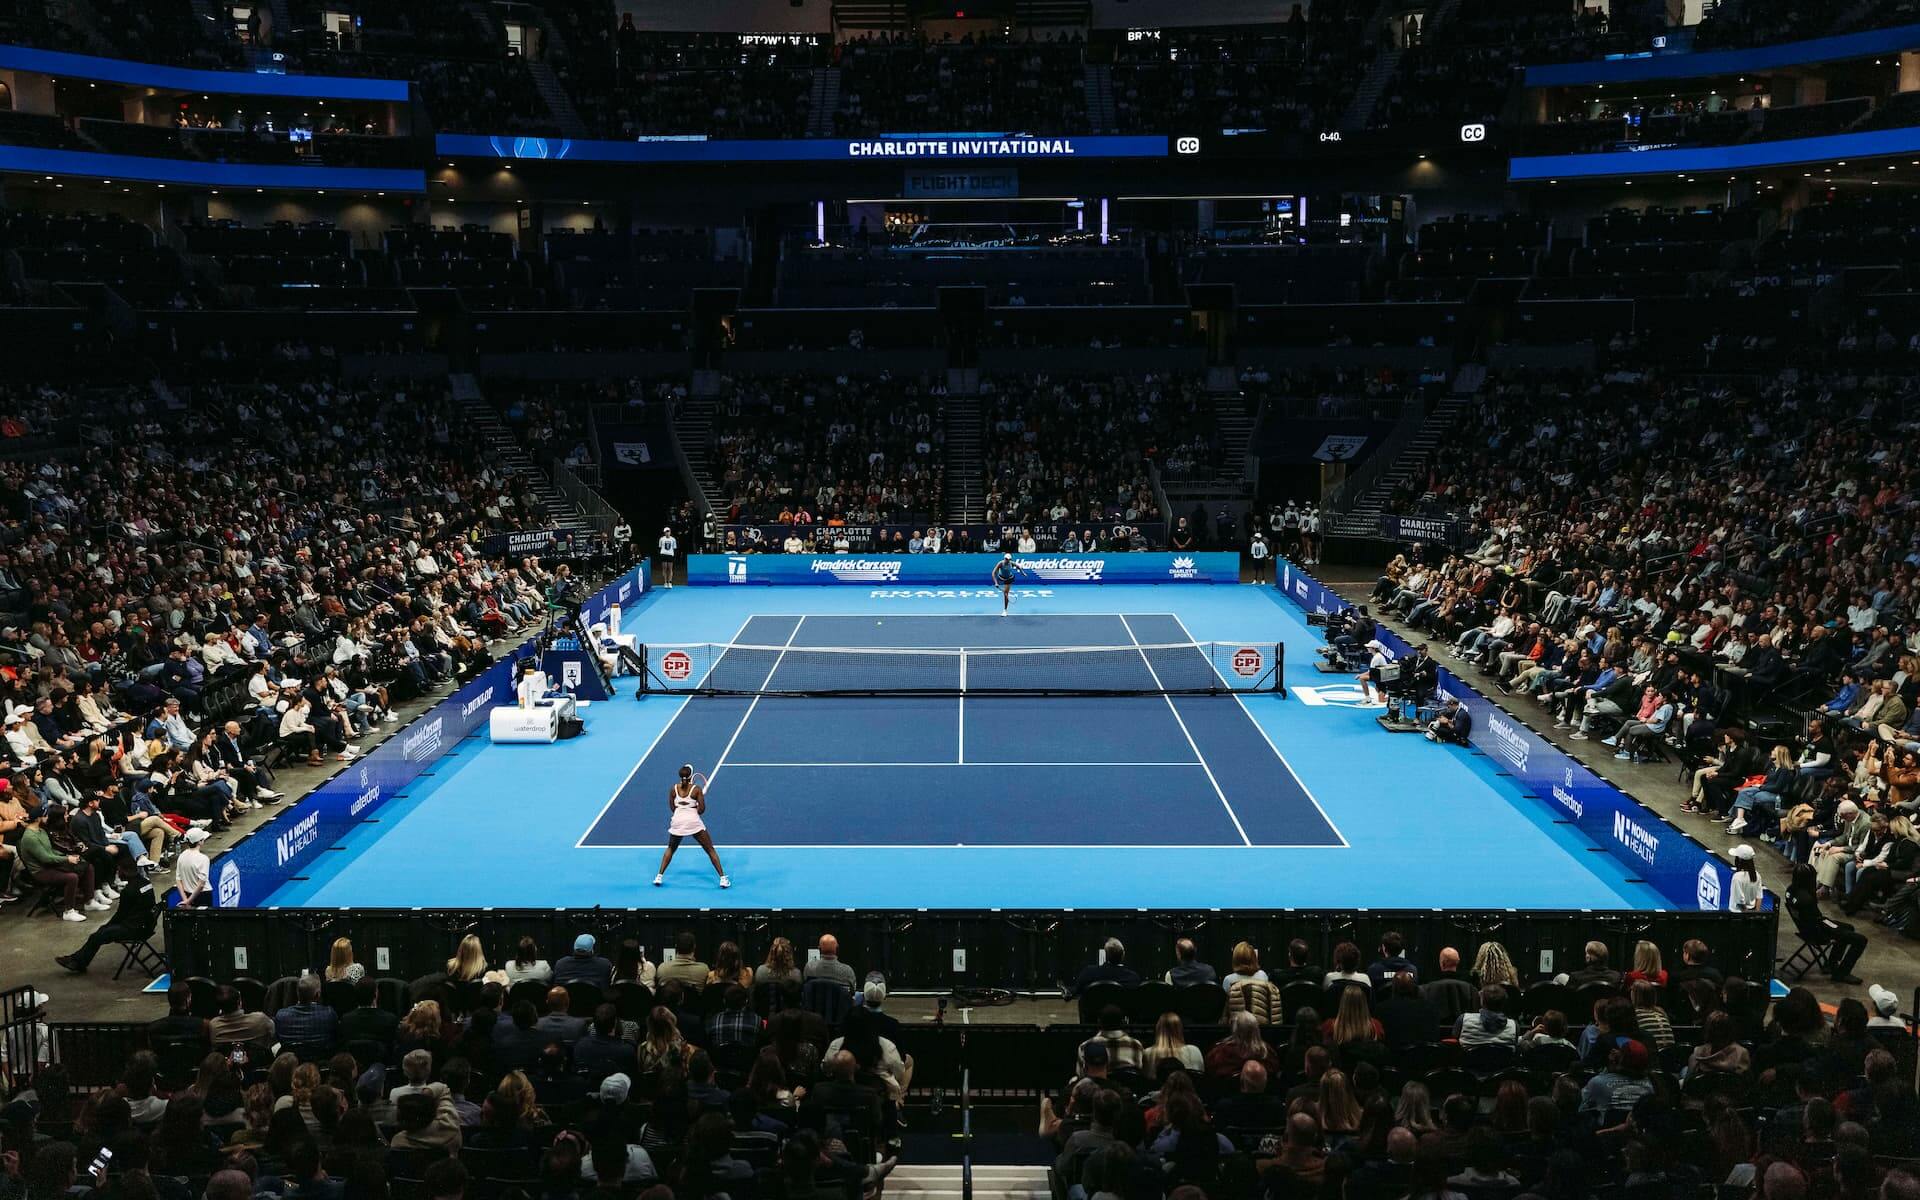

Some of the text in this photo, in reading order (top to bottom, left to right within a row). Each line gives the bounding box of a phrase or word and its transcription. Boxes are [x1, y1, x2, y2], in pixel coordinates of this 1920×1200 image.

[1463, 126, 1484, 140] CC
[849, 139, 1075, 156] CHARLOTTE INVITATIONAL
[1178, 138, 1198, 152] CC
[911, 175, 967, 190] FLIGHT
[1400, 518, 1446, 533] CHARLOTTE
[509, 531, 554, 545] CHARLOTTE
[664, 661, 690, 671] CPI
[1234, 658, 1261, 667] CPI
[467, 685, 494, 716] DUNLOP
[514, 725, 546, 734] waterdrop
[350, 784, 380, 817] waterdrop
[1552, 784, 1583, 819] waterdrop
[293, 809, 319, 840] NOVANT
[294, 826, 318, 854] HEALTH
[1630, 821, 1660, 851] NOVANT
[1629, 837, 1655, 866] HEALTH
[220, 876, 240, 903] CPI
[1700, 879, 1719, 907] CPI
